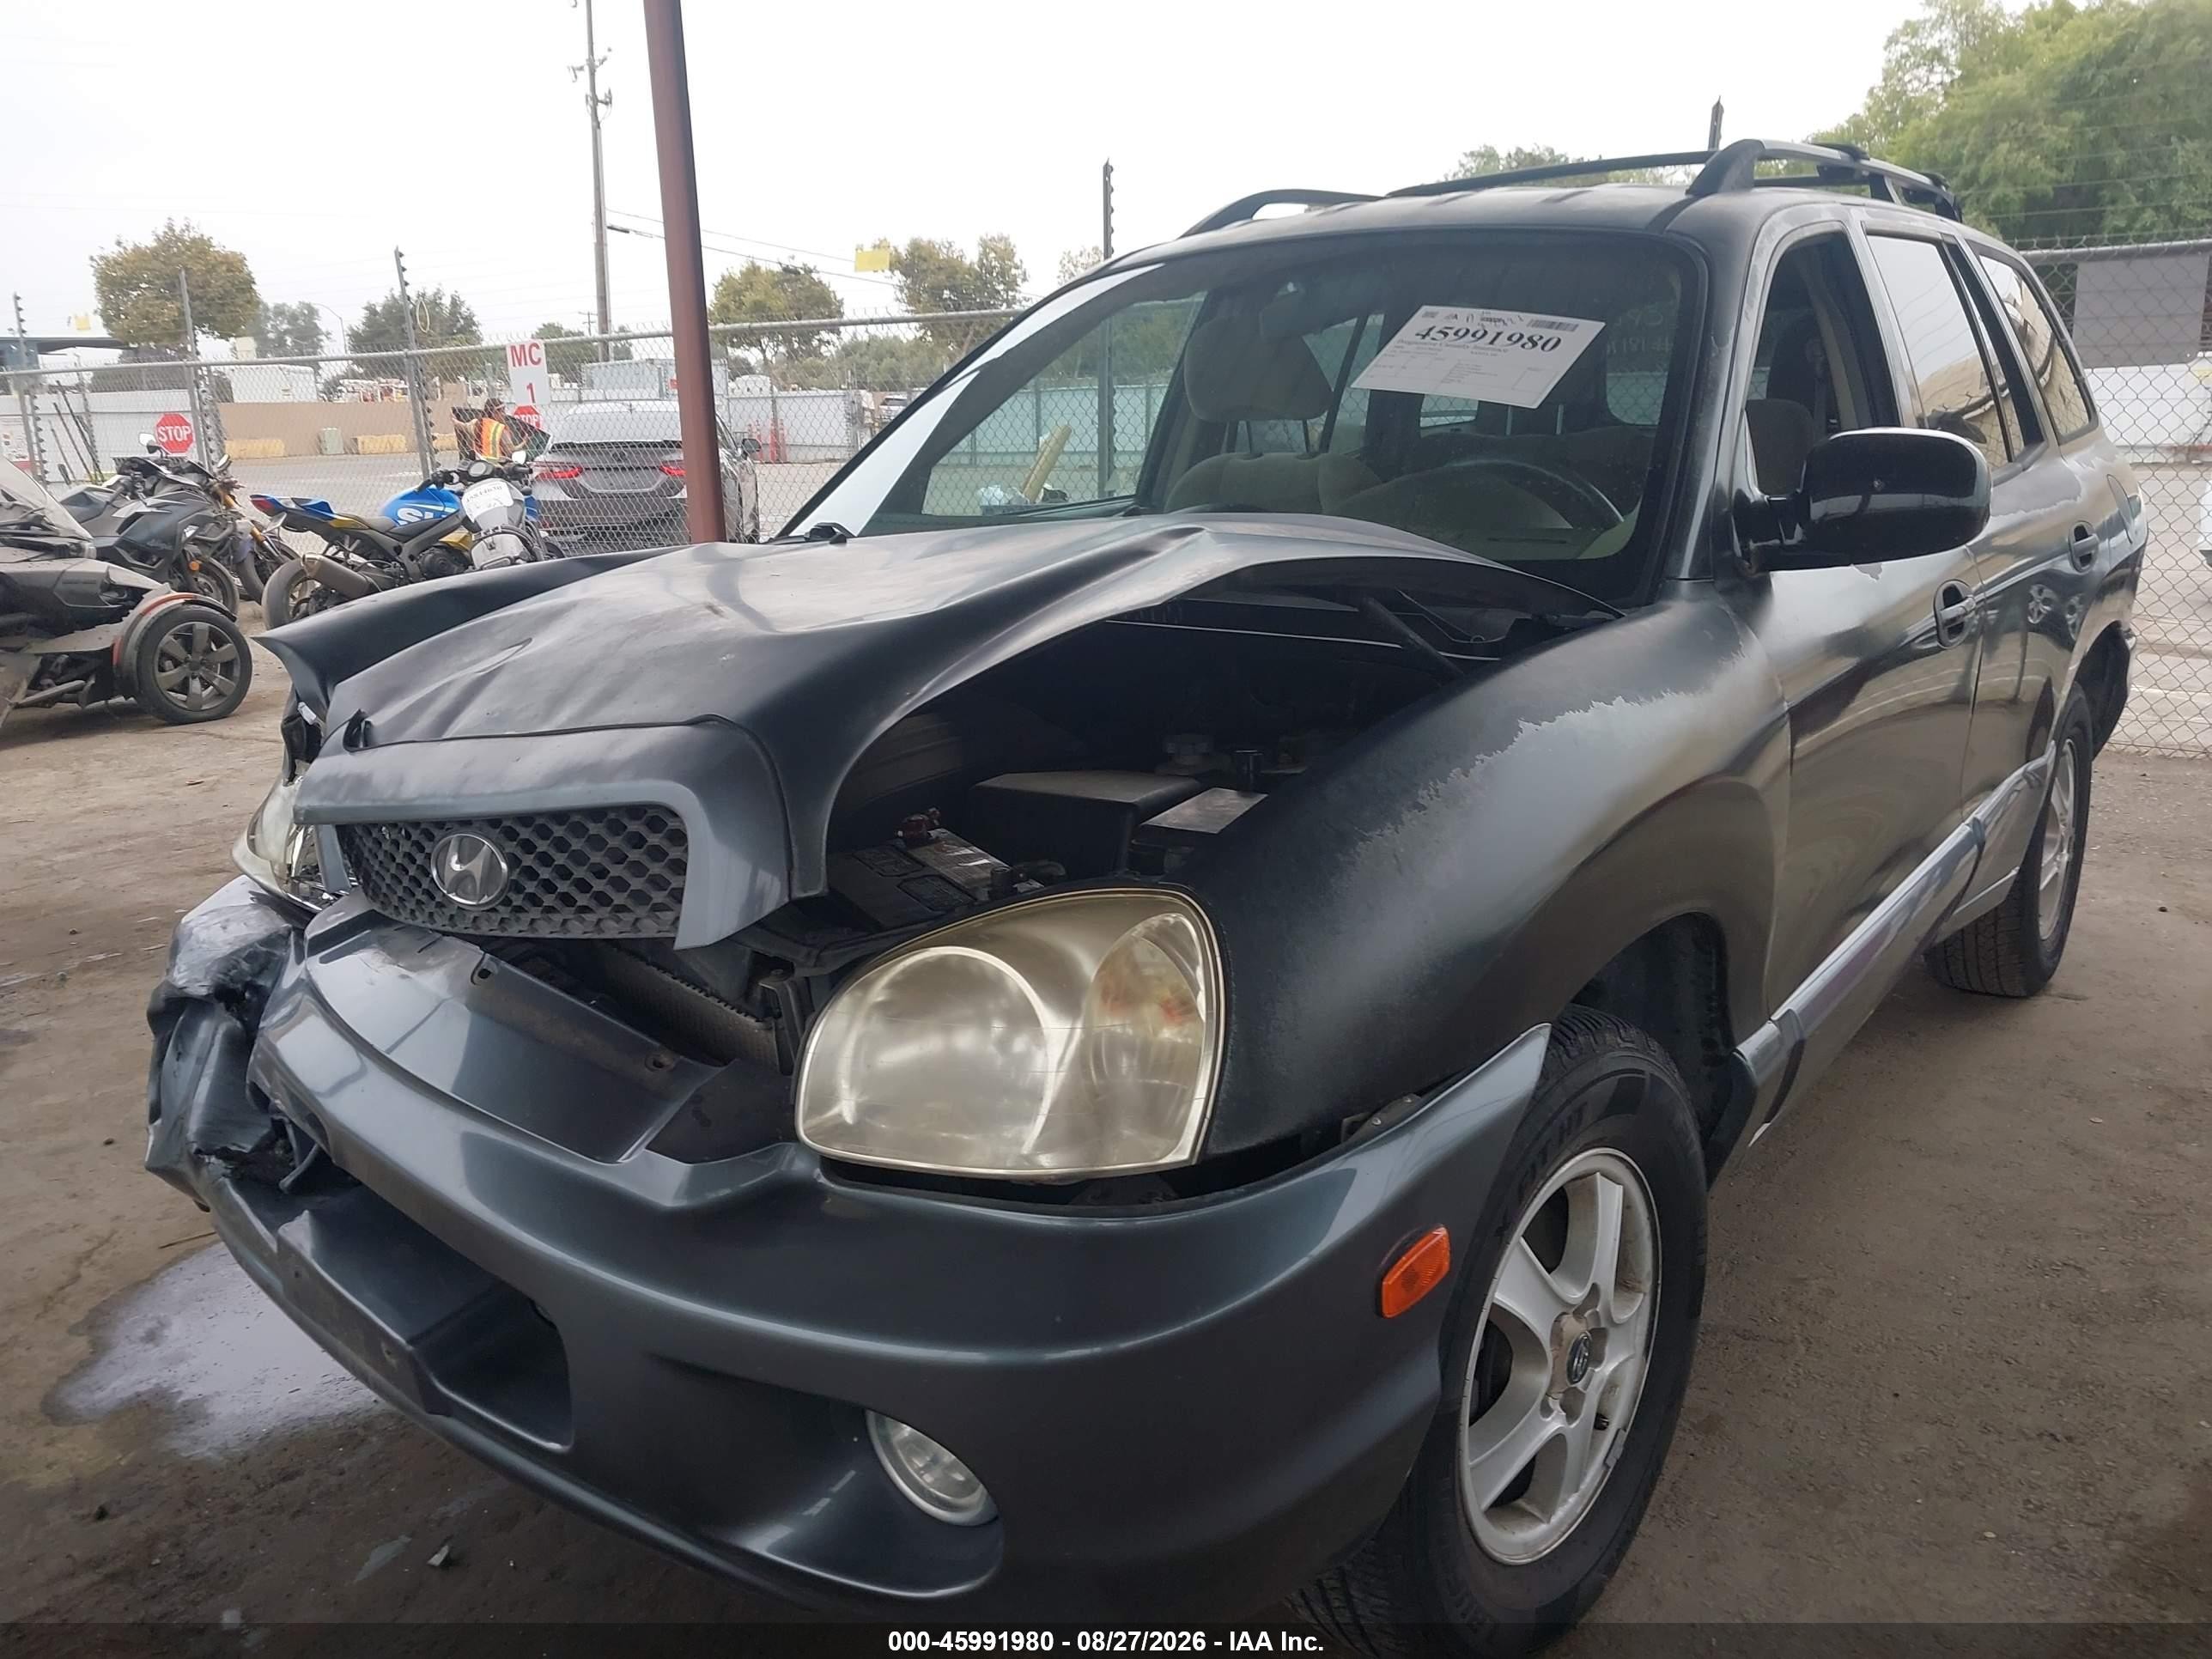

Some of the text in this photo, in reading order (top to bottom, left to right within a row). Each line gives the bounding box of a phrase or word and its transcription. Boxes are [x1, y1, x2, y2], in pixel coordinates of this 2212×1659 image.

[1415, 325, 1562, 353] 45991980
[510, 343, 542, 368] MC
[526, 382, 536, 404] 1
[157, 425, 191, 442] STOP
